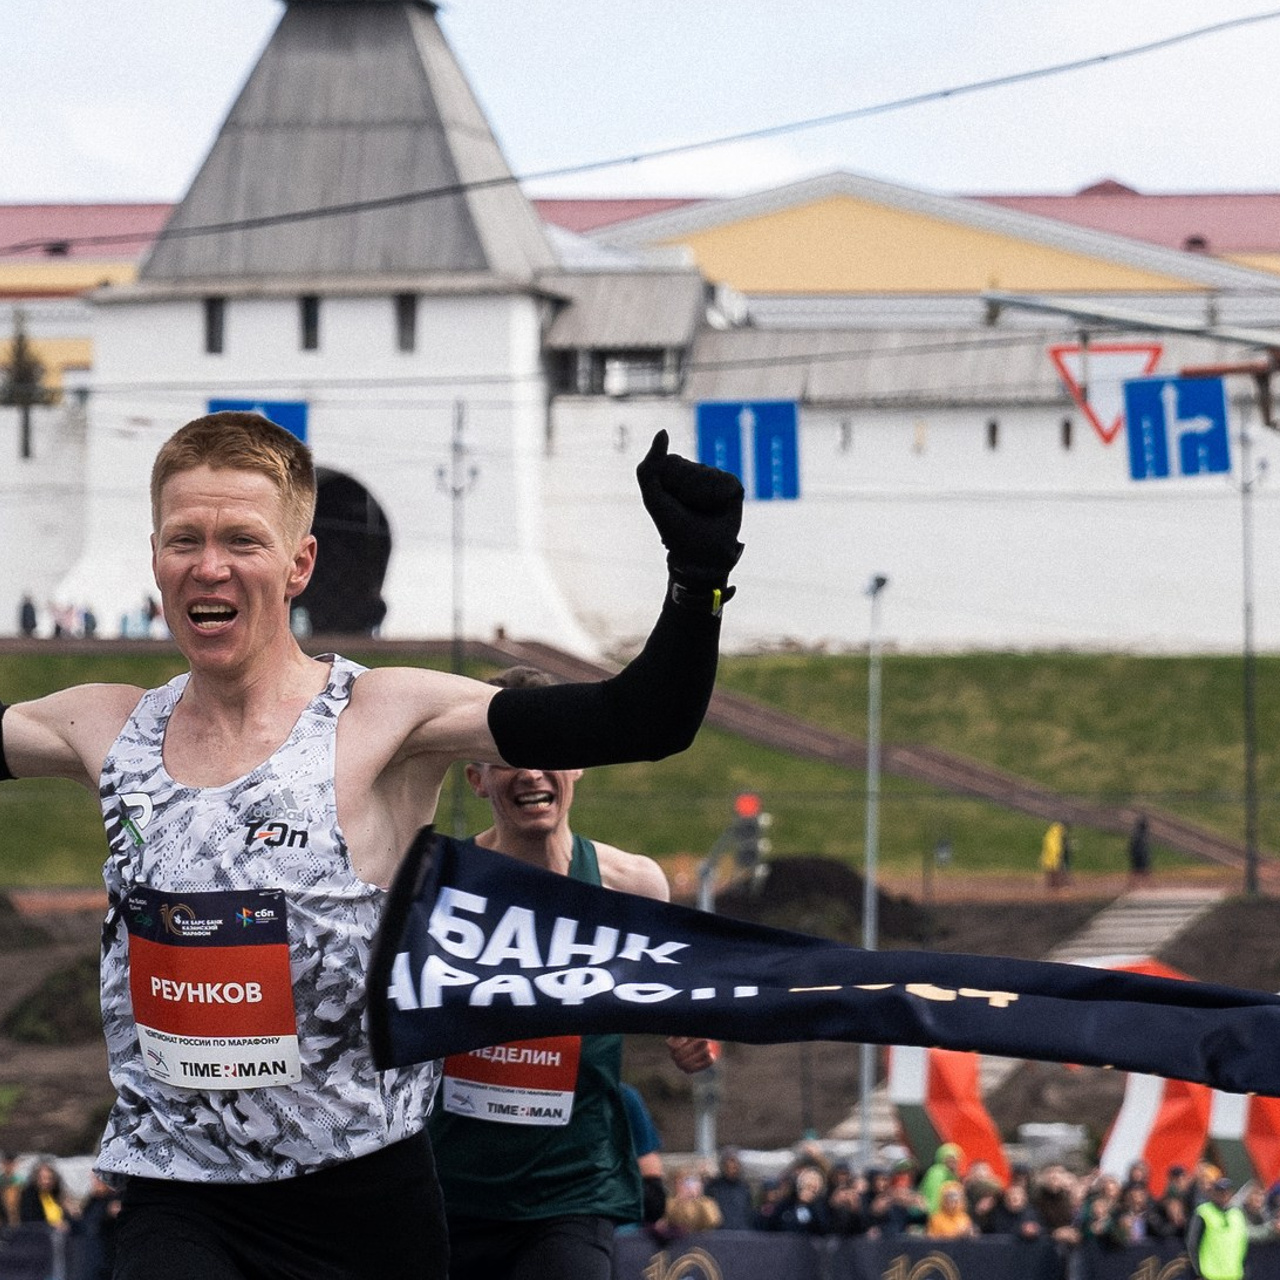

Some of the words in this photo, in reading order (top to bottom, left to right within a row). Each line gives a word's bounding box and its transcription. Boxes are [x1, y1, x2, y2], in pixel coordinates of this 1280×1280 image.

[429, 886, 691, 969] БАНК
[150, 975, 263, 1004] РЕУНКОВ
[179, 1038, 212, 1047] РОССИИ
[213, 1039, 226, 1047] ПО
[228, 1037, 281, 1047] МАРАФОНУ
